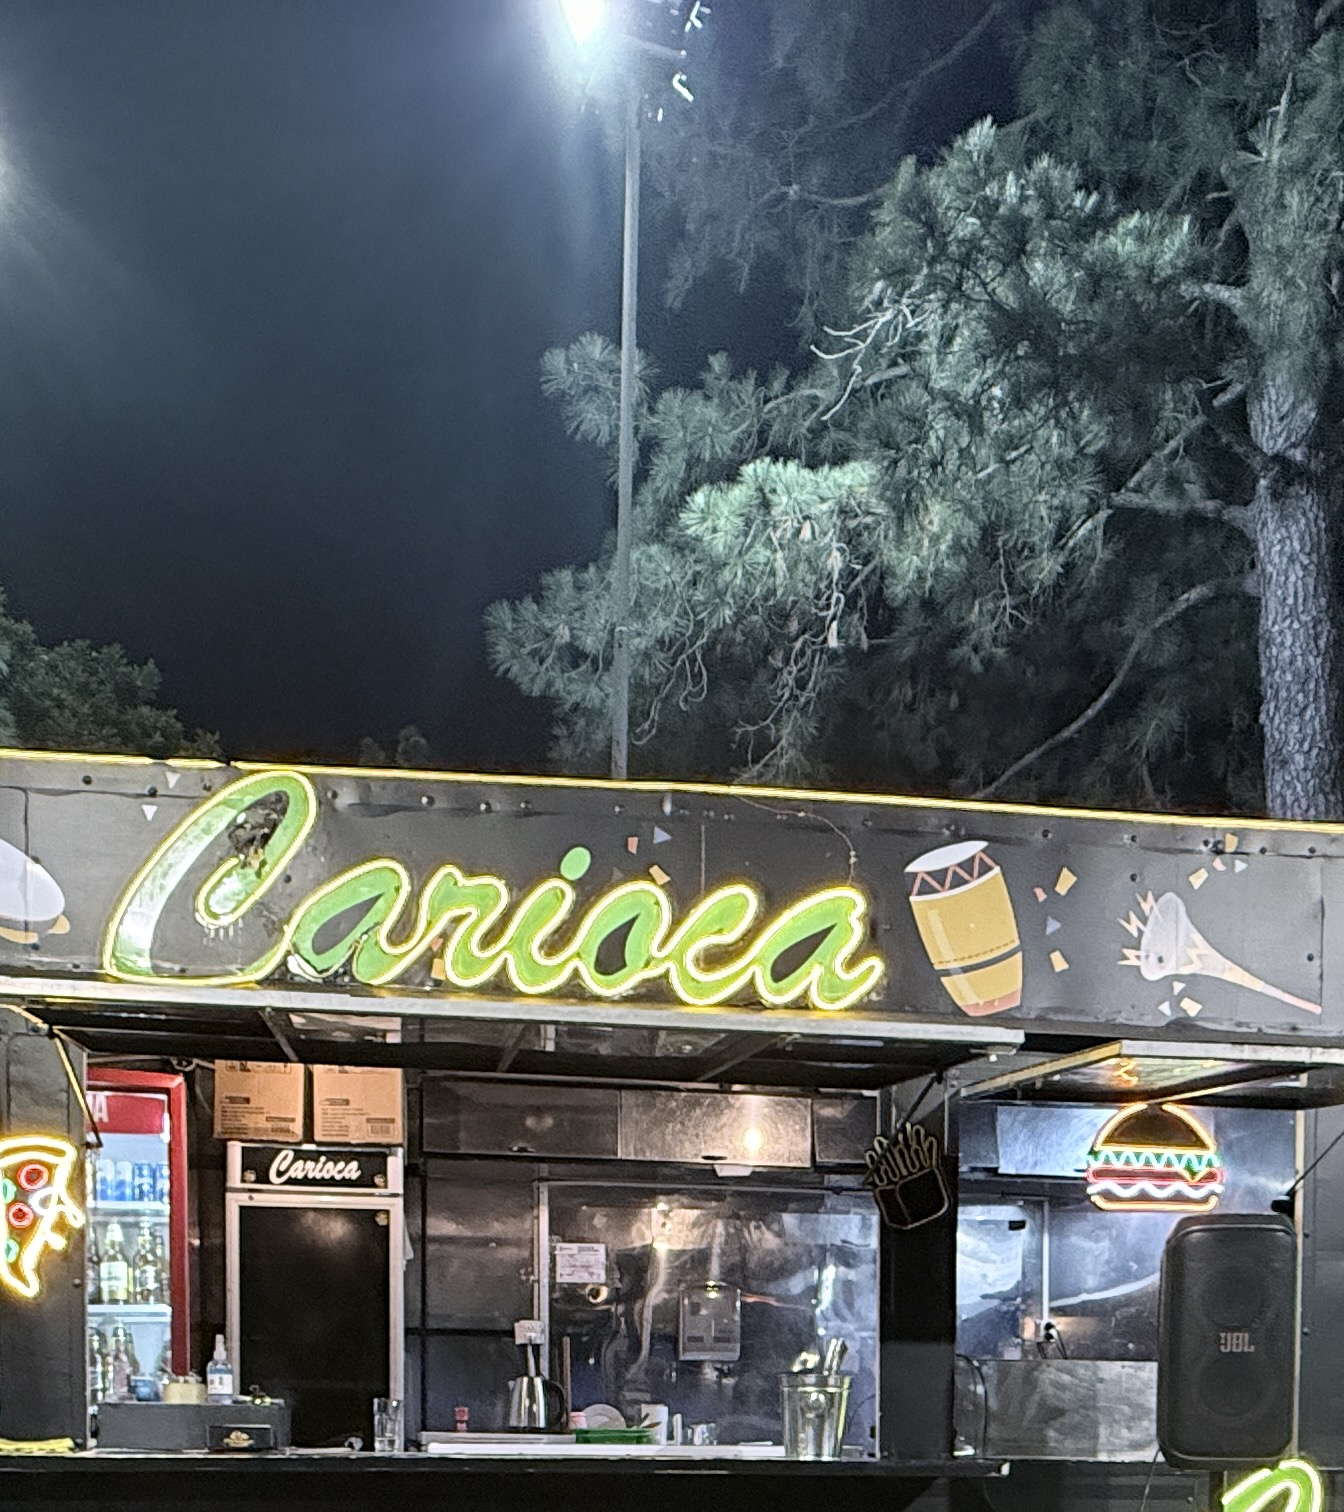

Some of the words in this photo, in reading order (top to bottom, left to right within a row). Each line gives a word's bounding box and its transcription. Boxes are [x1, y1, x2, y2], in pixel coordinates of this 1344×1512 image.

[102, 769, 884, 1011] Carioca
[269, 1149, 362, 1185] Carioca
[1219, 1332, 1255, 1353] JBL
